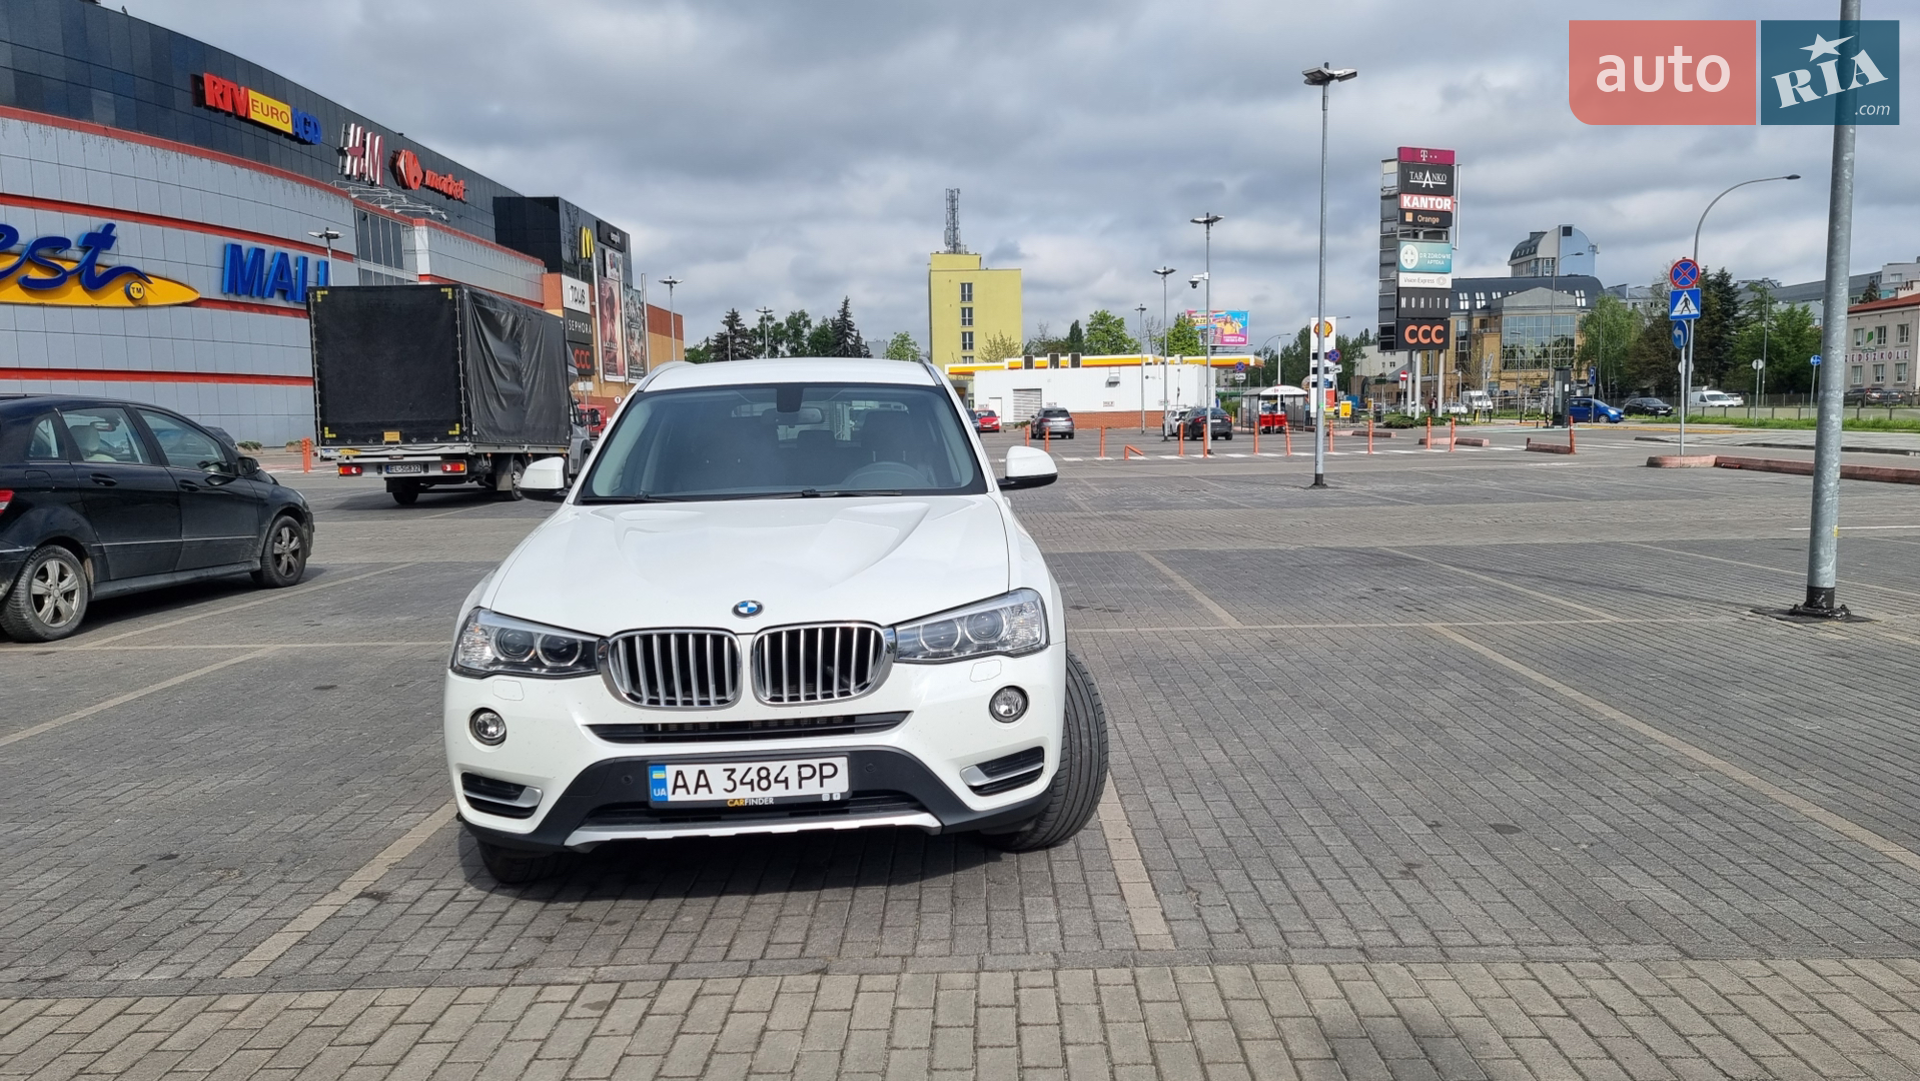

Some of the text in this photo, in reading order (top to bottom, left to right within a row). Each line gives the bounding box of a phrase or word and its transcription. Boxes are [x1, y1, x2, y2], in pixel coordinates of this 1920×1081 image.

[203, 72, 322, 145] RTV EURO AGD
[425, 169, 466, 201] market
[1409, 169, 1447, 188] TARANKO
[1402, 195, 1452, 210] KANTOR
[1417, 214, 1440, 224] Orange
[1401, 296, 1449, 309] MOHITO
[568, 320, 592, 334] SEPHORA
[1404, 324, 1445, 345] CCC
[574, 348, 591, 369] CCC
[653, 762, 839, 797] UA AA 3484 PP
[726, 796, 775, 808] CARFINDER
